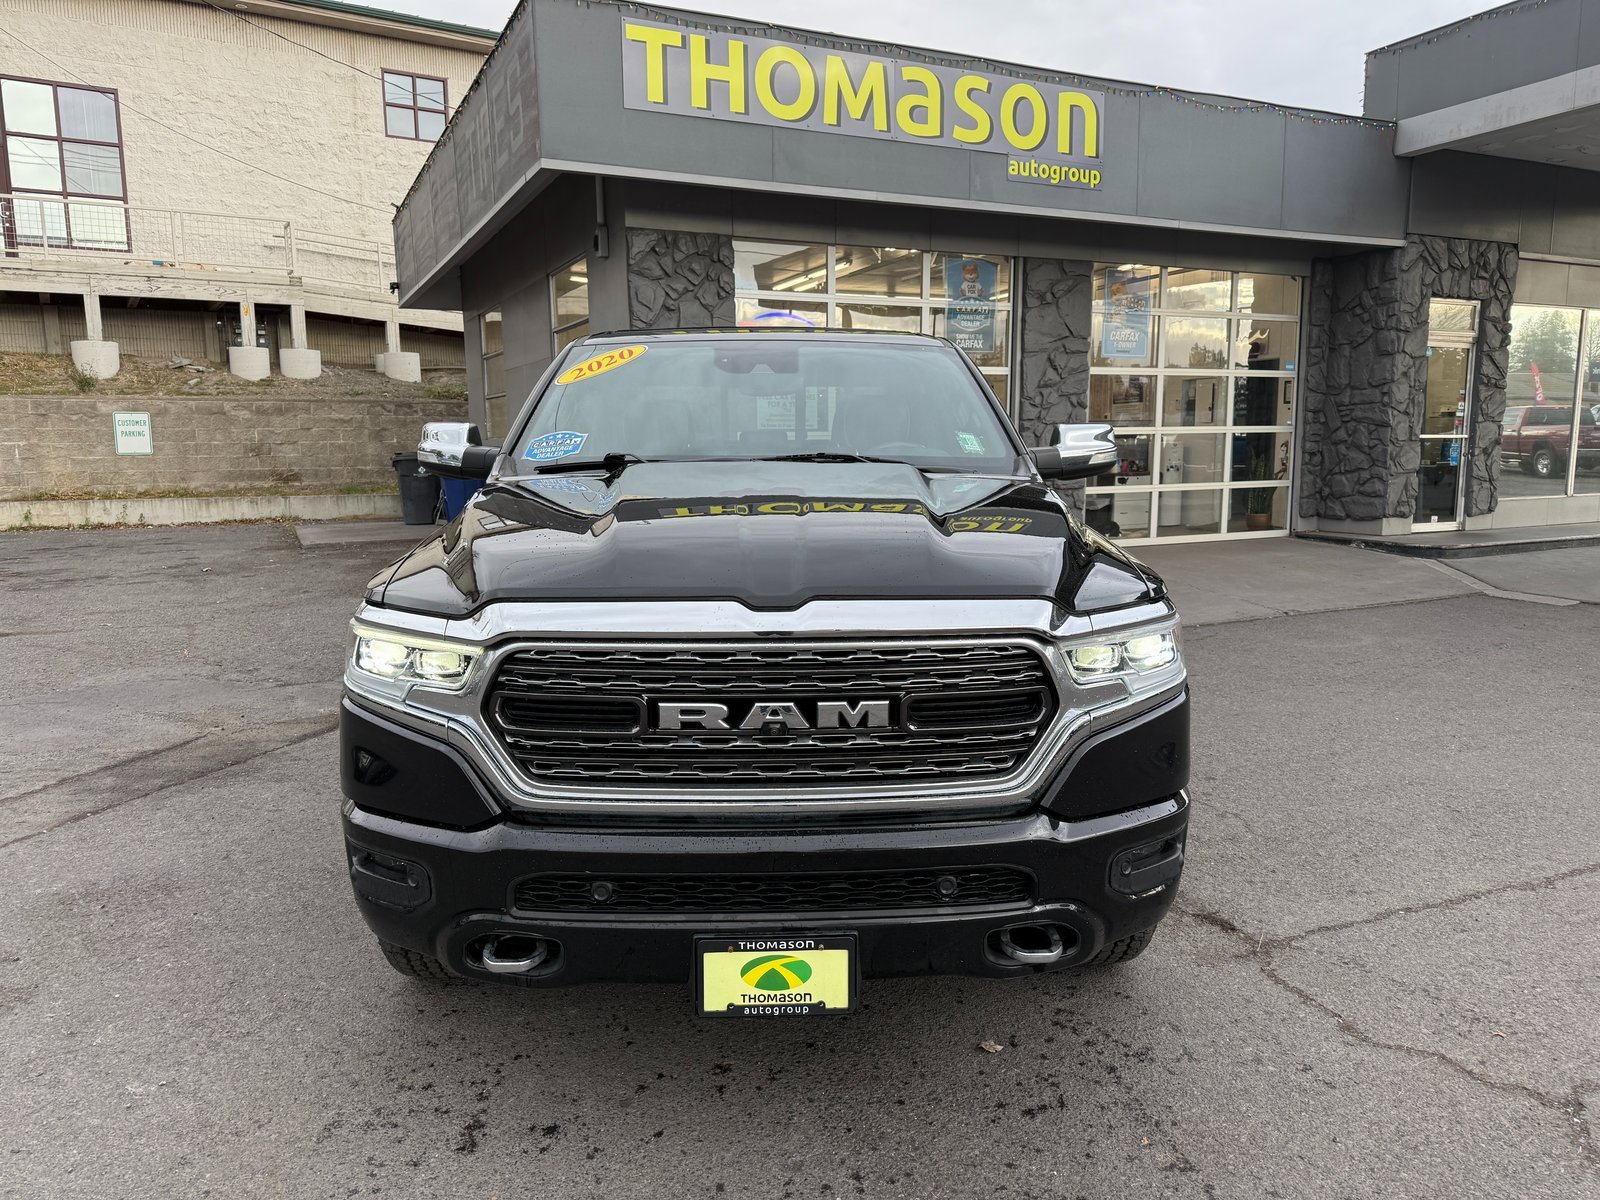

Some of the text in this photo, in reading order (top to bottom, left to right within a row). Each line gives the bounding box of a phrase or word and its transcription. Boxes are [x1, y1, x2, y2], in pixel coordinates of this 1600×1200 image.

[1008, 157, 1101, 188] autogroup
[1110, 331, 1140, 341] CARFAX
[956, 340, 983, 348] CARFAX
[570, 348, 634, 380] 2020
[532, 445, 574, 454] ADVANTAGE
[658, 701, 890, 730] RAM
[743, 1005, 809, 1016] autogroup
